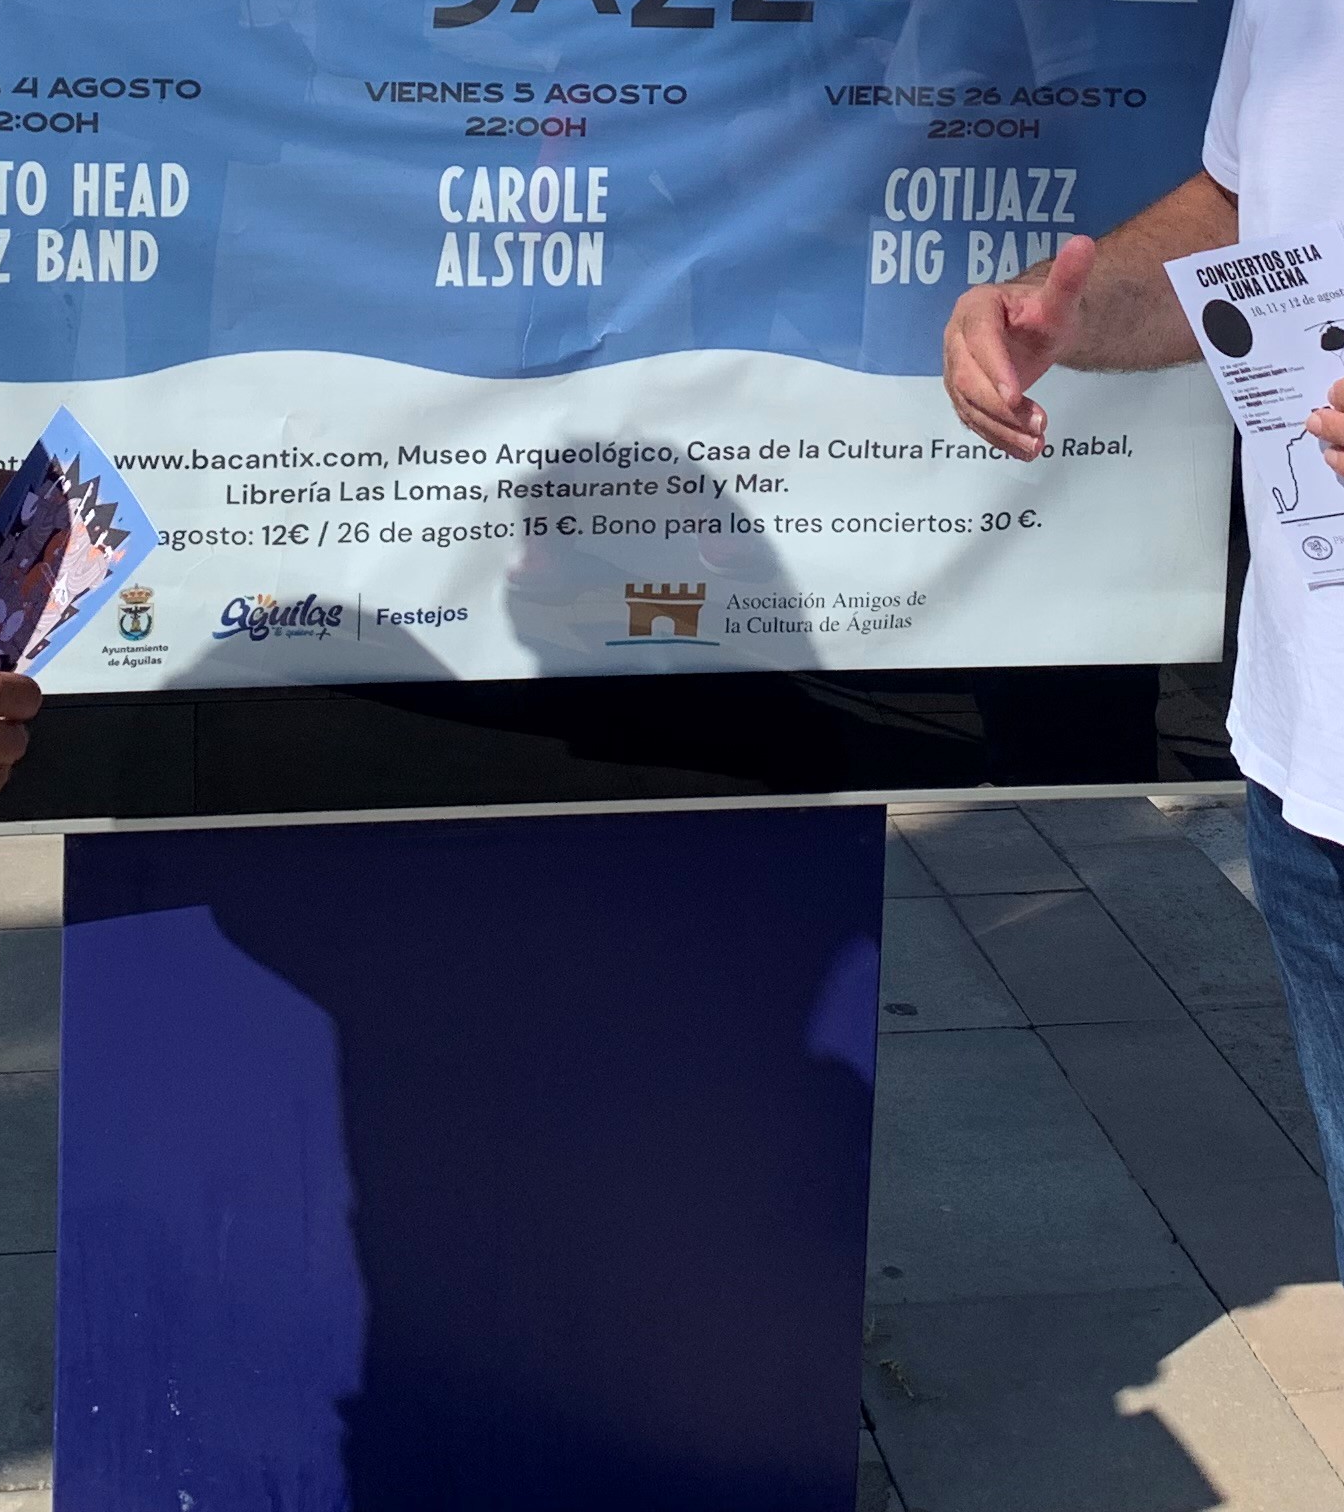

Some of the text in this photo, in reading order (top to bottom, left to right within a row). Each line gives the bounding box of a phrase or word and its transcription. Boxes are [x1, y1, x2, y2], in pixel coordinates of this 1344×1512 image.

[12, 75, 39, 98] 4
[47, 78, 202, 102] AGOSTO
[365, 80, 688, 105] VIERNES 5 AGOSTO
[825, 85, 1147, 108] VIERNES 26 AGOSTO
[465, 117, 587, 138] 22:00H
[928, 118, 1039, 139] 22:00H
[73, 162, 189, 218] HEAD
[438, 166, 609, 223] CAROLE
[884, 167, 1077, 223] COTIJAZZ
[37, 229, 159, 283] BAND
[436, 231, 604, 287] ALSTON
[871, 230, 944, 285] BIG
[1196, 244, 1322, 288] CONCIERTOS DE LA
[1225, 267, 1309, 302] LUNA LLENA
[114, 434, 1134, 473] www.bacantix.com, Museo Arqueológico, Casa de la Cultura Franco Rabal,
[226, 473, 789, 505] Librería Las Lomas, Restaurante Sol y Mar.
[262, 524, 309, 545] 12€
[318, 521, 327, 548] /
[337, 522, 370, 543] 26
[379, 521, 411, 543] de
[422, 519, 514, 547] agosto:
[523, 516, 549, 536] 15
[556, 515, 585, 536] €.
[592, 513, 656, 536] Bono
[664, 517, 722, 538] para
[730, 513, 764, 534] los
[774, 513, 824, 533] tres
[831, 512, 974, 534] conciertos:
[980, 511, 1012, 532] 30
[1018, 509, 1043, 531] €.
[376, 604, 468, 627] Festejos
[726, 589, 927, 615] Asociación Amigos de
[725, 610, 912, 635] la Cultura de Águilas
[102, 644, 169, 656] Ayuntamiento
[108, 655, 162, 668] de Águilas
